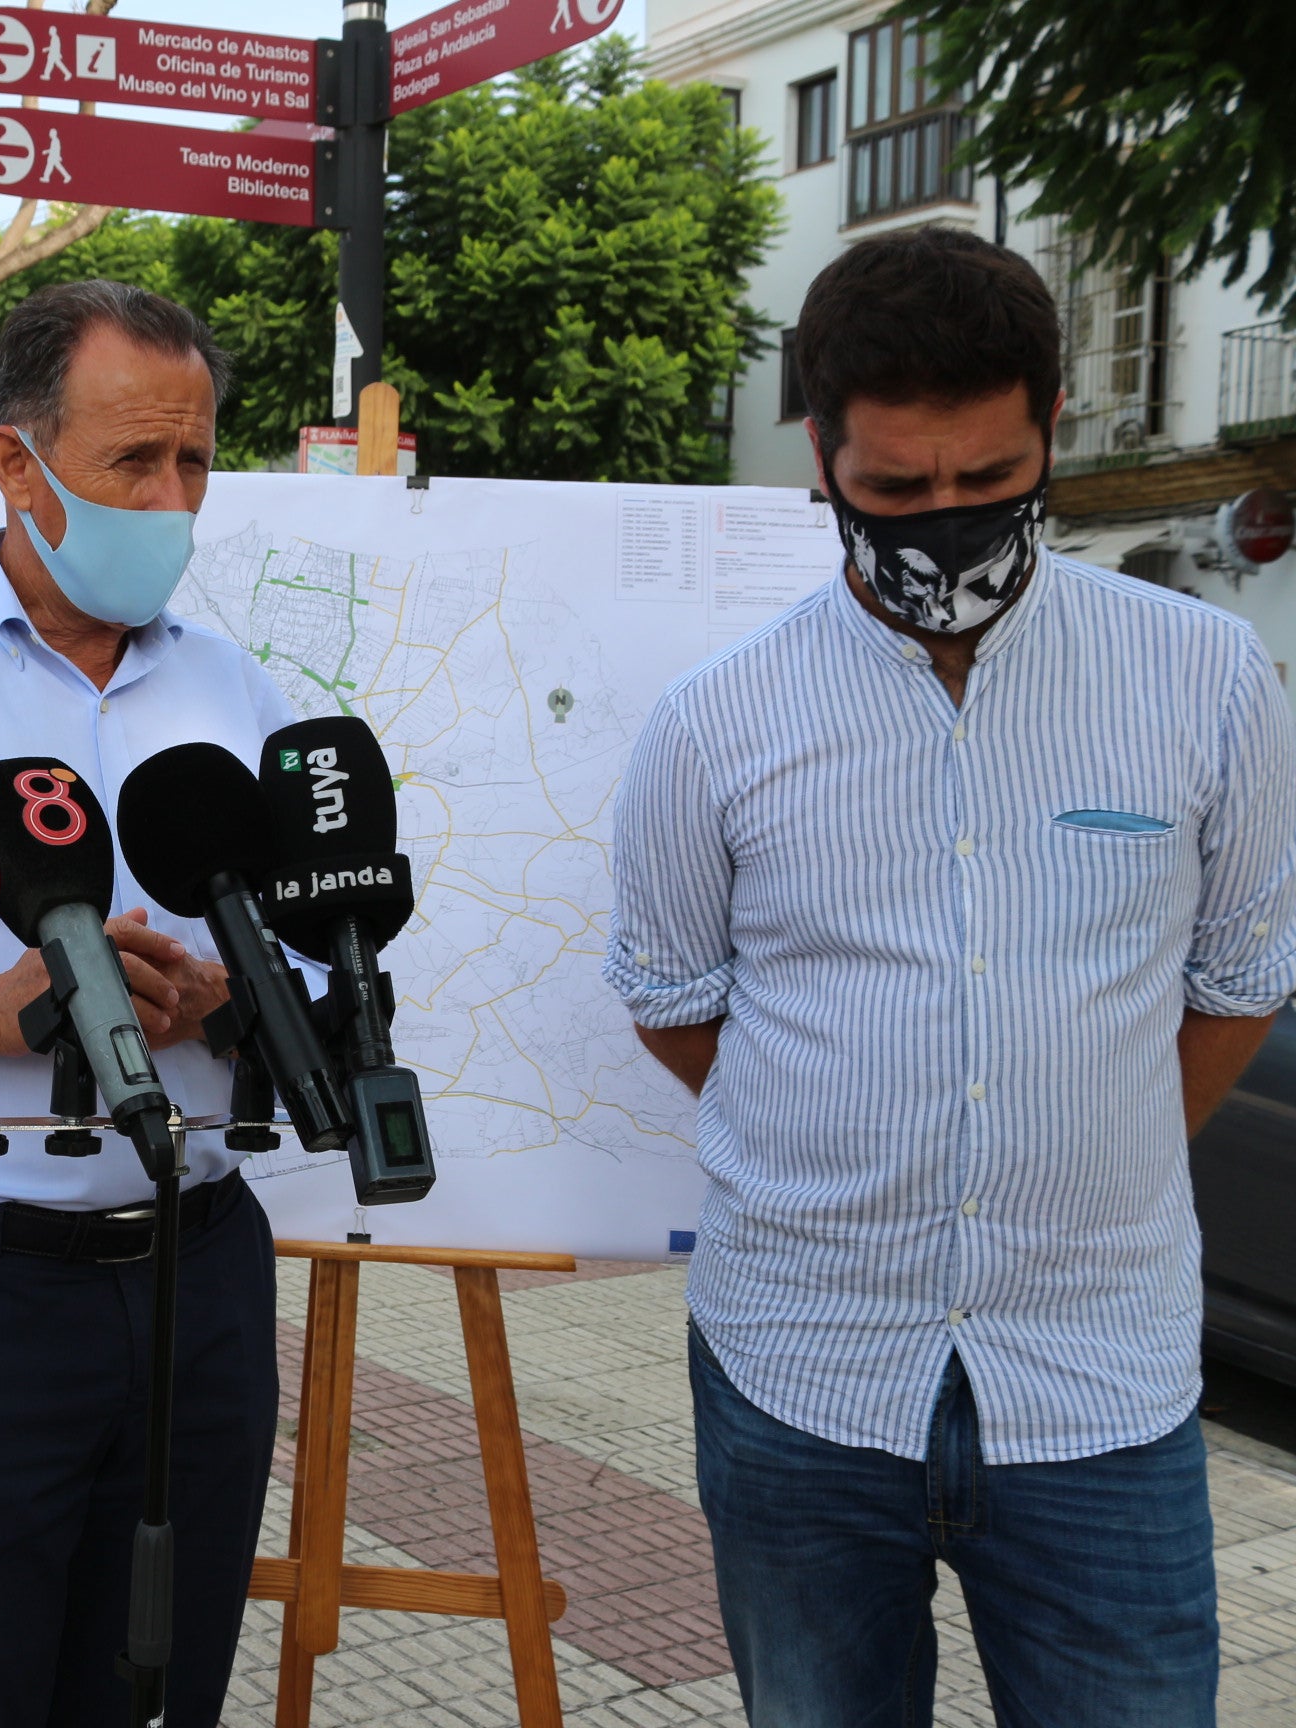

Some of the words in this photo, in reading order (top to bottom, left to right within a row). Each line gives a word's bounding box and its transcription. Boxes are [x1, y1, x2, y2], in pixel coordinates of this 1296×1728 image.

[138, 28, 213, 52] Mercado
[217, 37, 239, 54] de
[242, 39, 309, 63] Abastos
[394, 28, 428, 58] Iglesia
[430, 19, 451, 39] San
[394, 55, 423, 79] Plaza
[424, 47, 439, 66] de
[440, 23, 496, 59] Andalucía
[157, 54, 216, 75] Oficina
[220, 61, 241, 78] de
[245, 63, 309, 87] Turismo
[393, 72, 440, 103] Bodegas
[118, 73, 176, 95] Museo
[180, 81, 207, 99] del
[210, 82, 247, 103] Vino
[251, 91, 261, 107] y
[265, 89, 280, 106] la
[284, 91, 309, 110] Sal
[180, 147, 231, 169] Teatro
[236, 153, 310, 178] Moderno
[227, 176, 310, 201] Biblioteca
[306, 746, 350, 834] tuya
[276, 880, 301, 901] la
[309, 865, 394, 899] janda
